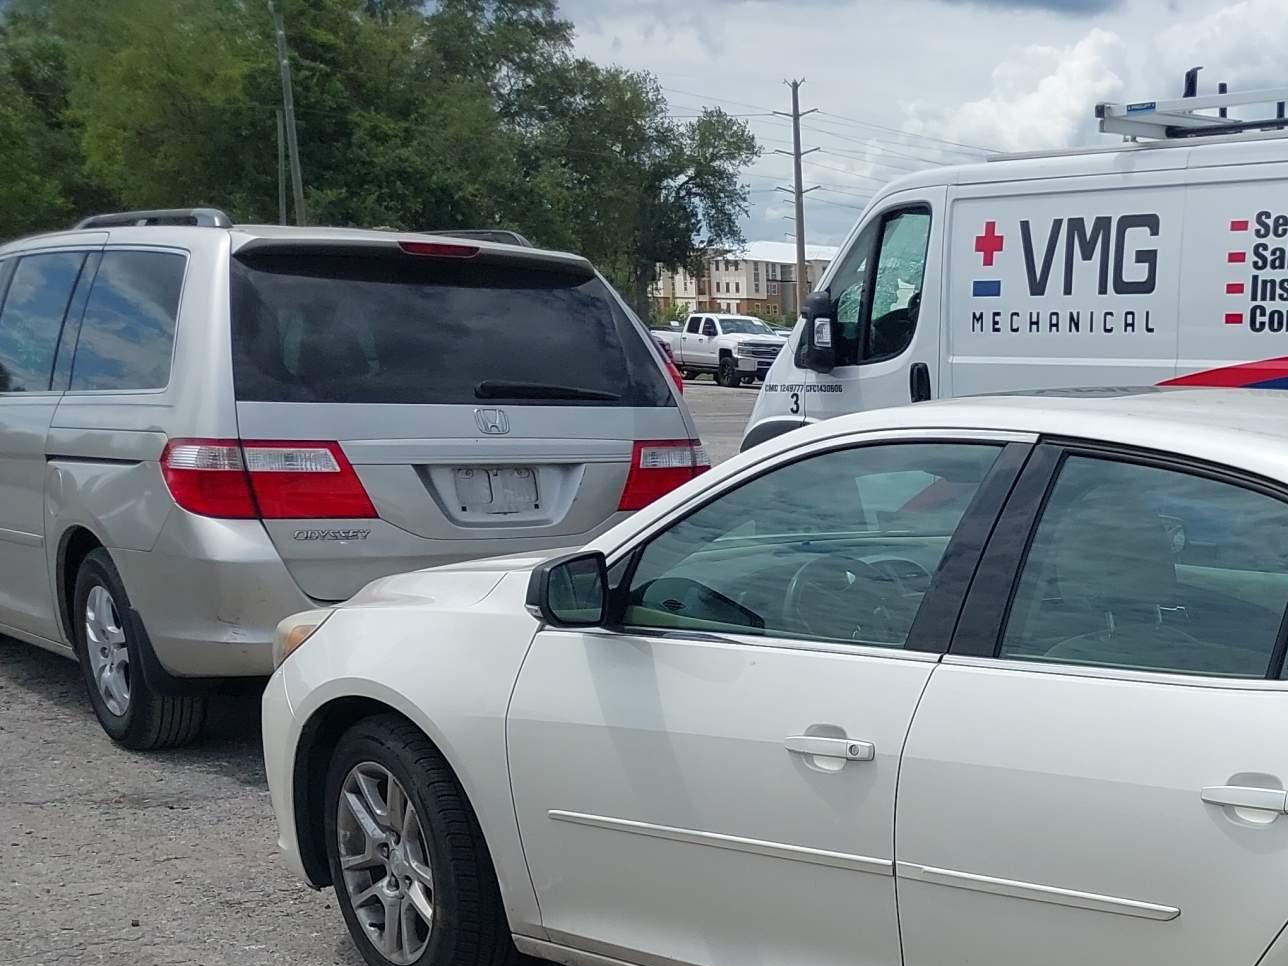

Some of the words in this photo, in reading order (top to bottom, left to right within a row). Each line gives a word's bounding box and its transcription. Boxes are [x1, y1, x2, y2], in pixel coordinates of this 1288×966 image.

[1019, 213, 1161, 297] VMG
[971, 311, 1156, 334] MECHANICAL
[789, 393, 800, 414] 3
[293, 529, 372, 541] ODYSSEY
